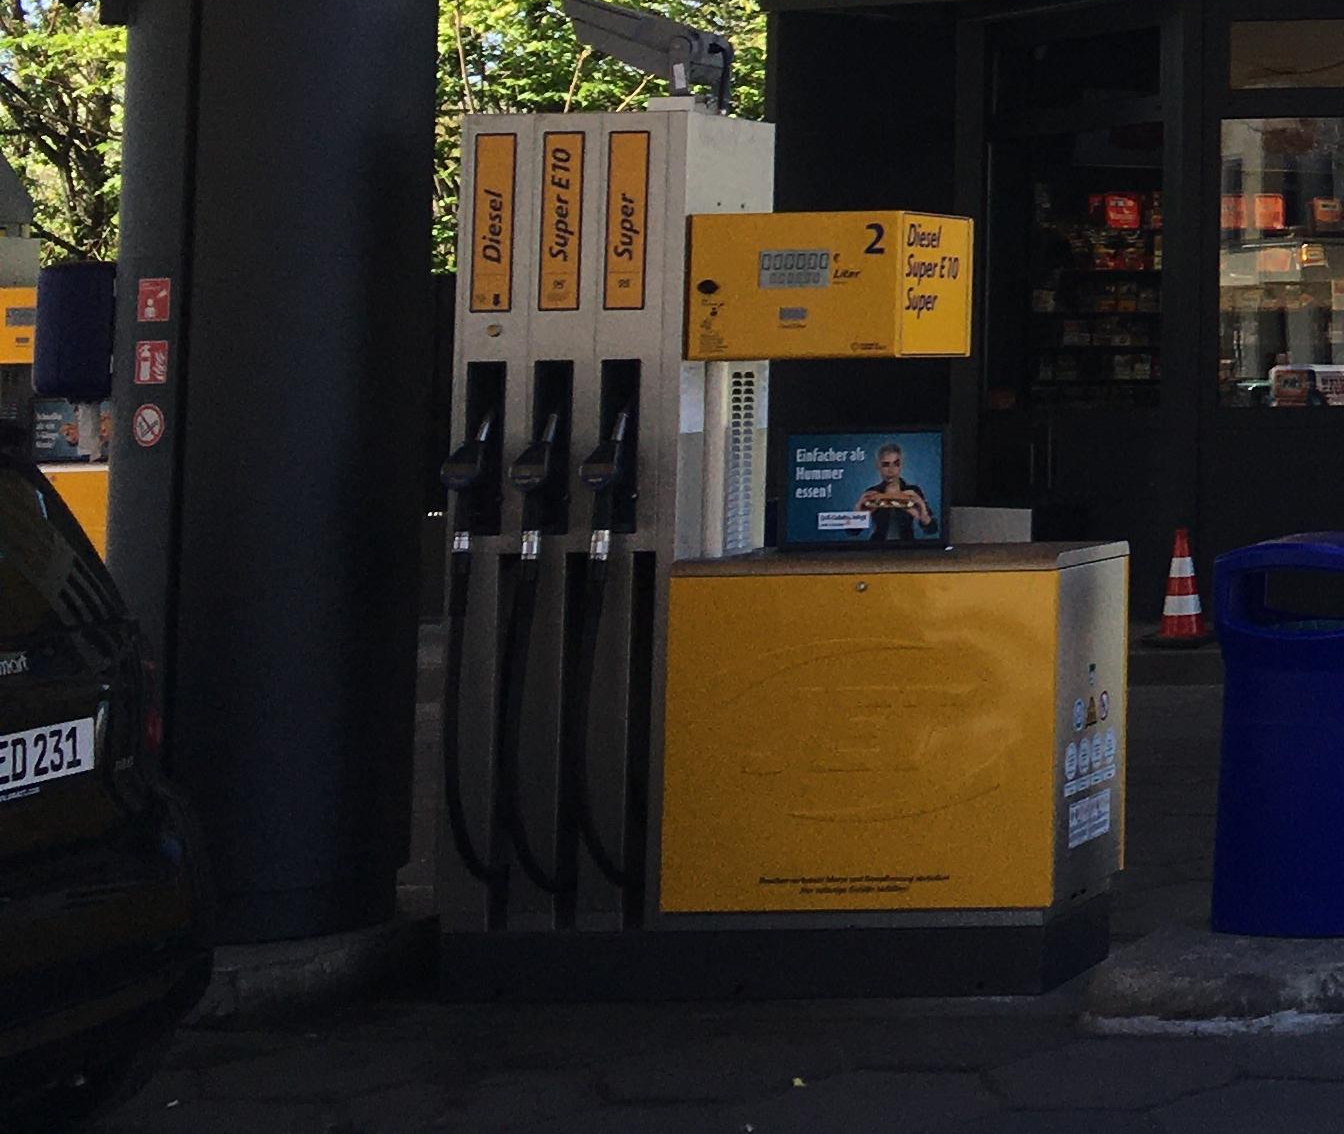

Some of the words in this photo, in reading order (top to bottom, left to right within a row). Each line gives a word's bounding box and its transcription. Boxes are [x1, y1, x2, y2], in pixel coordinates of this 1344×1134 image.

[551, 147, 571, 189] E10
[482, 188, 504, 264] Diesel
[549, 193, 576, 261] Super
[614, 193, 641, 260] Super
[865, 223, 886, 255] 2
[907, 223, 942, 249] Diesel
[833, 269, 860, 279] Liter
[906, 254, 938, 285] Super
[940, 257, 960, 280] E10
[905, 287, 937, 318] Super
[796, 448, 847, 463] Einfacher
[849, 447, 865, 462] als
[796, 467, 844, 480] Hummer
[795, 484, 832, 498] essen!
[34, 726, 82, 777] 231
